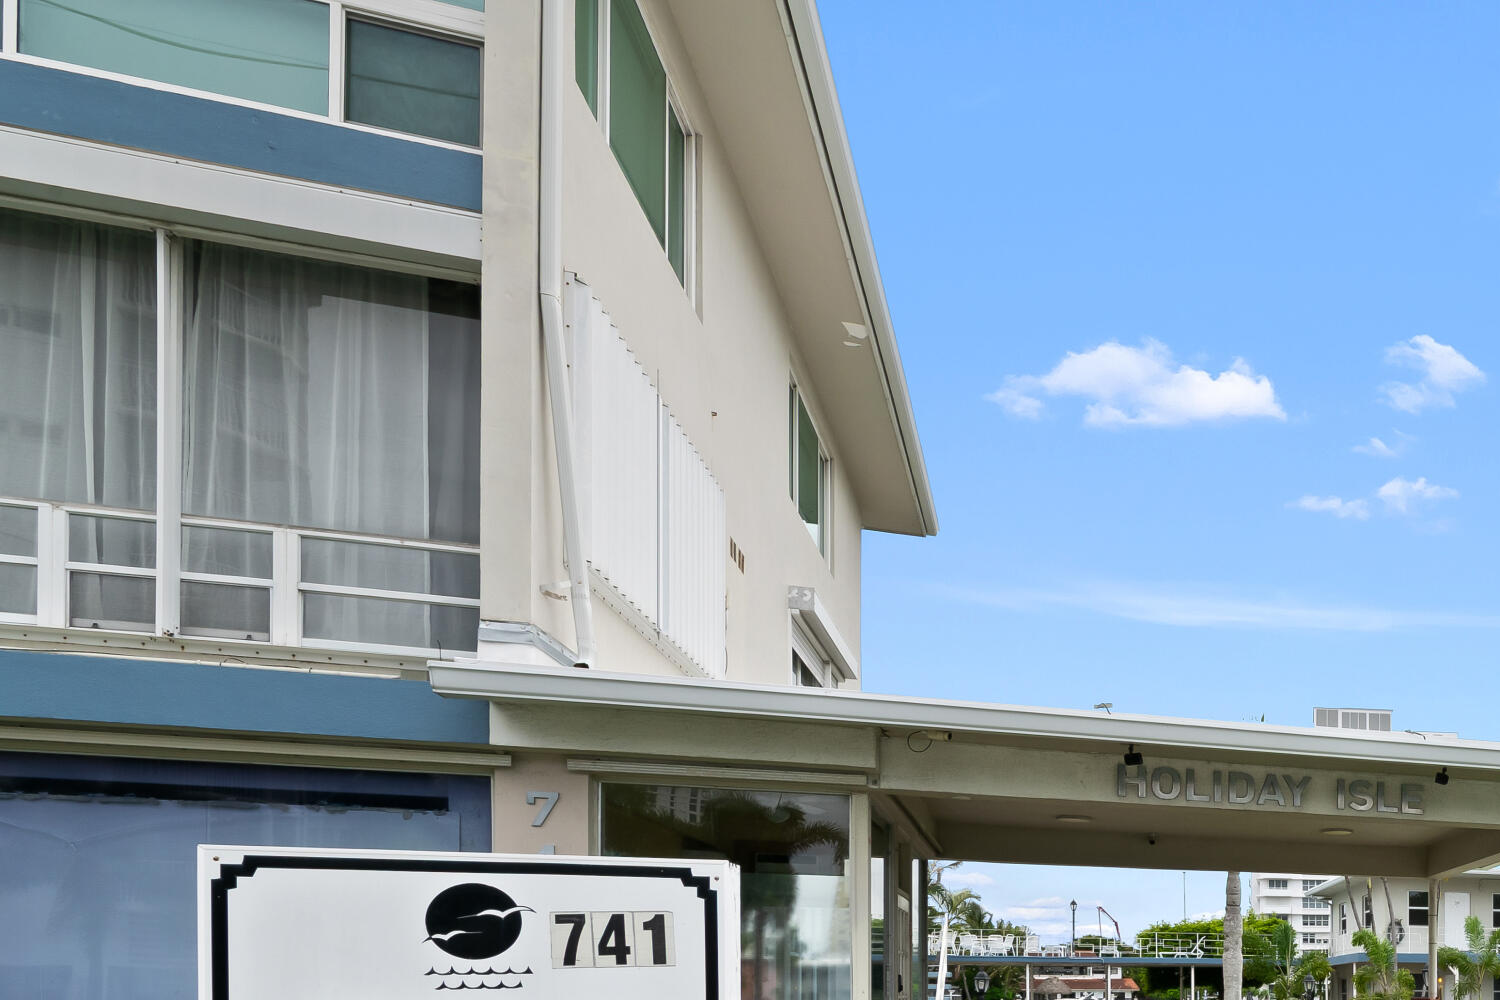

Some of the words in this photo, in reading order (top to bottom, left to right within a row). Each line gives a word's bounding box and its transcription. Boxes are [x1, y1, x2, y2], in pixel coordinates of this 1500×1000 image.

[1116, 763, 1312, 807] HOLIDAY
[1336, 777, 1425, 815] ISLE
[554, 913, 667, 967] 741
